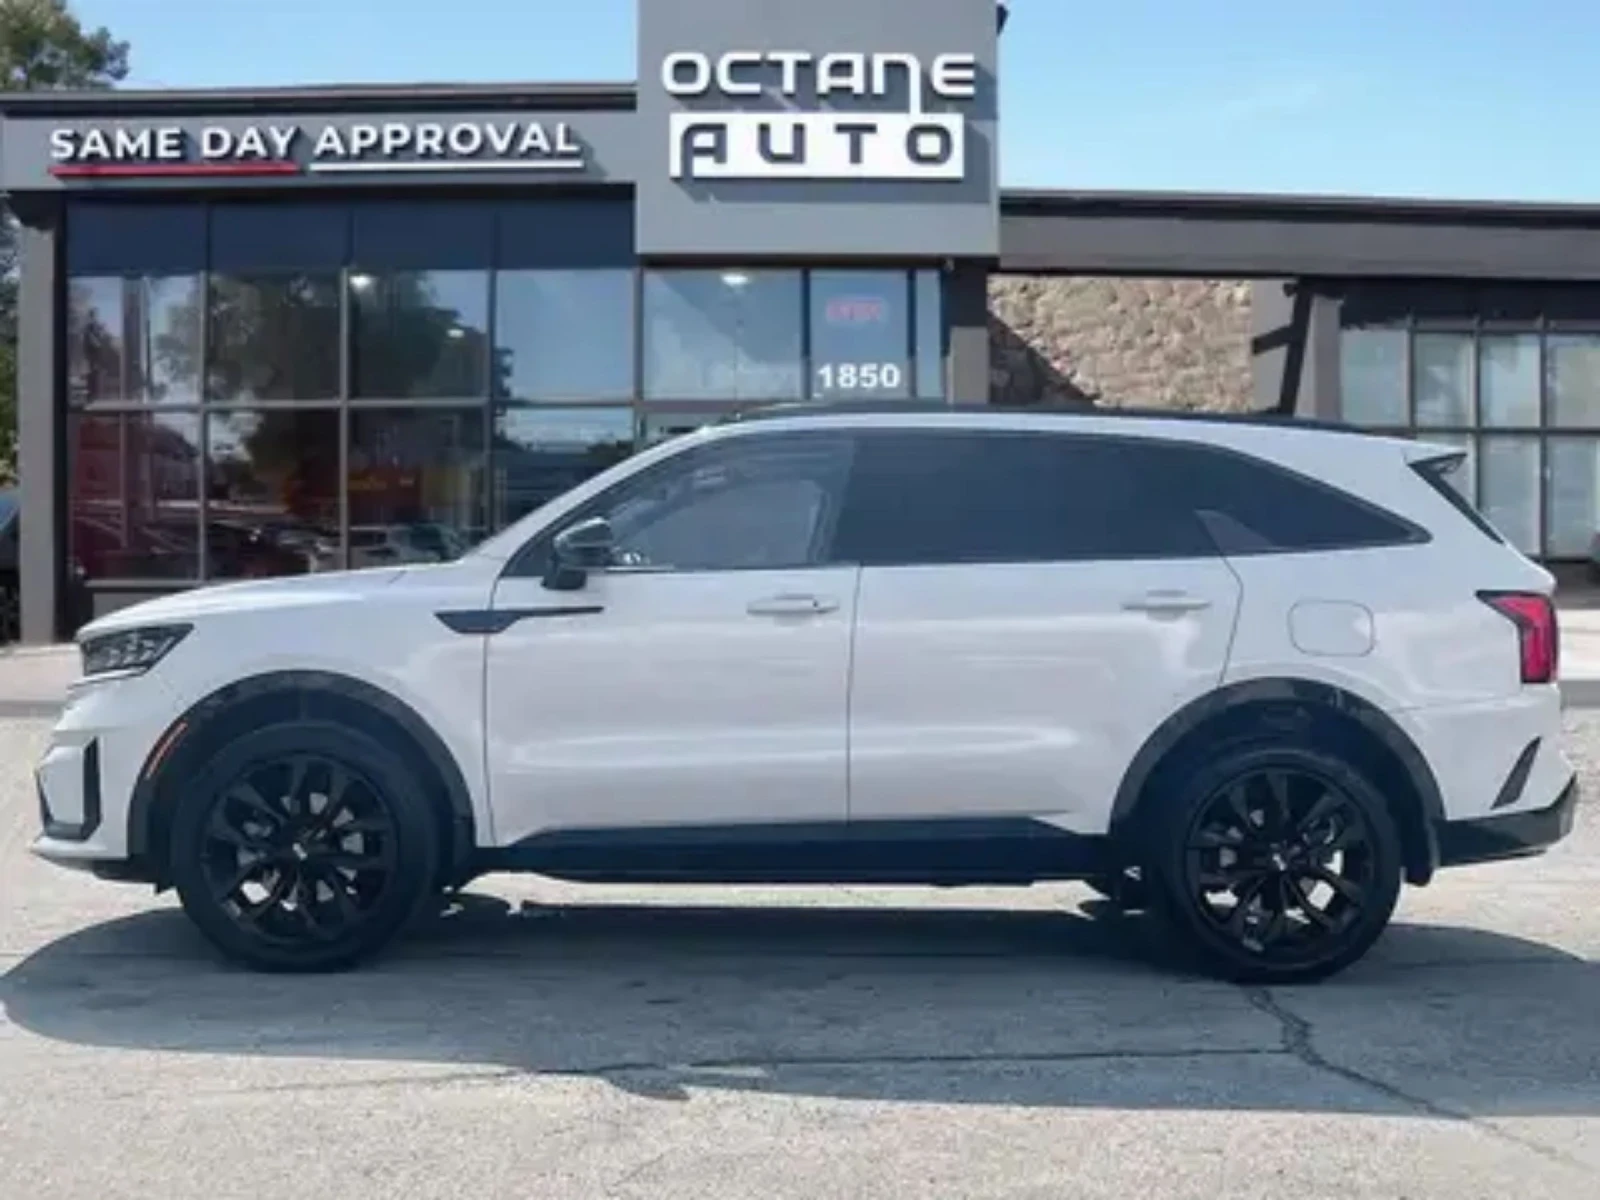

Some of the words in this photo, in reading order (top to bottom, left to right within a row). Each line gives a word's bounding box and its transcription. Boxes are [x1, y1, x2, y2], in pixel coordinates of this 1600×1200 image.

[661, 52, 976, 114] OCTANE
[49, 128, 182, 160] SAME
[201, 125, 298, 158] DAY
[313, 121, 580, 156] APPROVAL
[680, 123, 953, 178] AUTO
[816, 363, 901, 389] 1850
